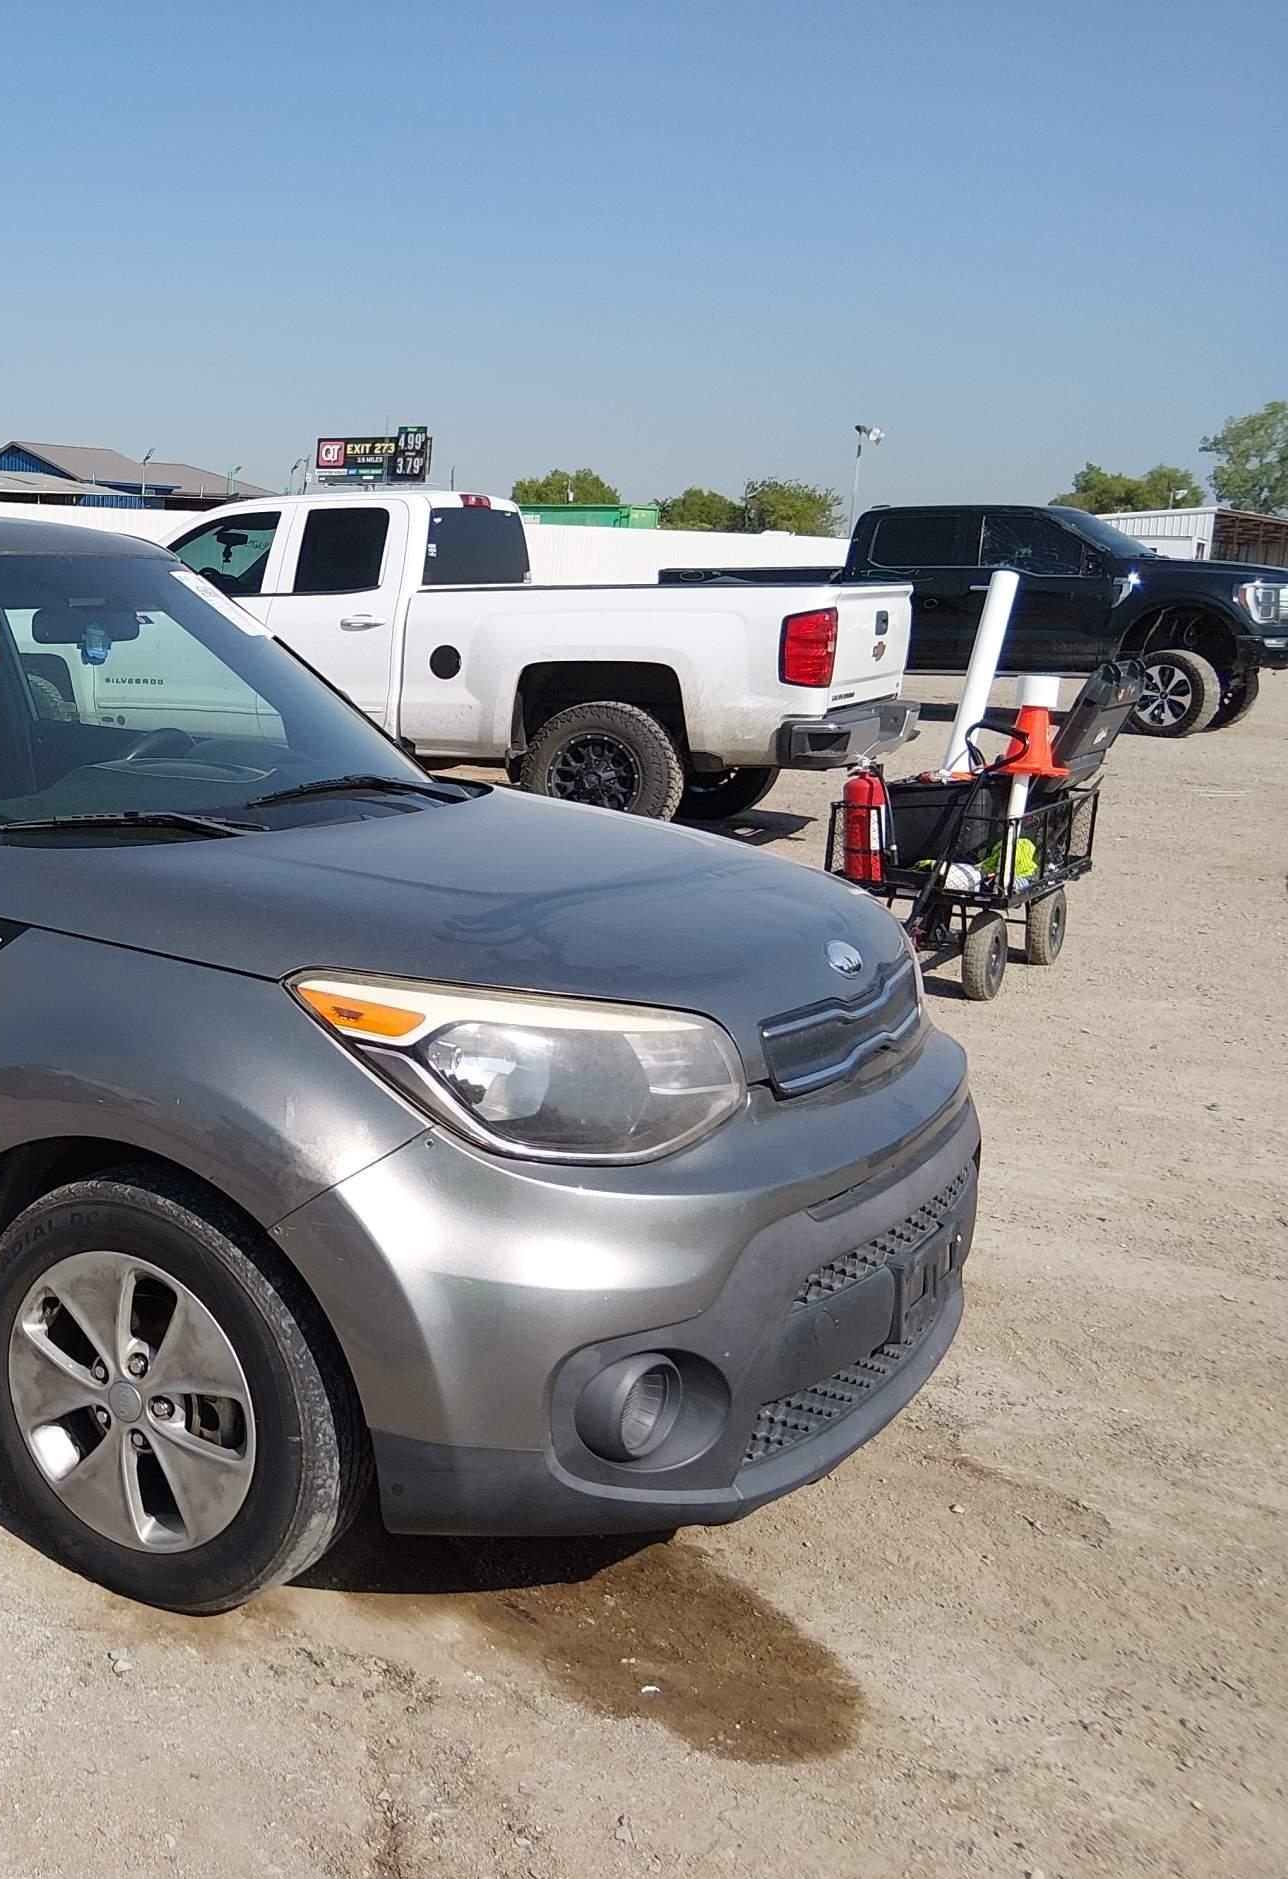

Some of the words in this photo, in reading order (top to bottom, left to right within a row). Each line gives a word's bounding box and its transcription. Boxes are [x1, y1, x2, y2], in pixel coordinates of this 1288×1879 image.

[346, 443, 372, 454] EXIT
[374, 442, 396, 454] 273
[105, 677, 164, 686] SILVERADO
